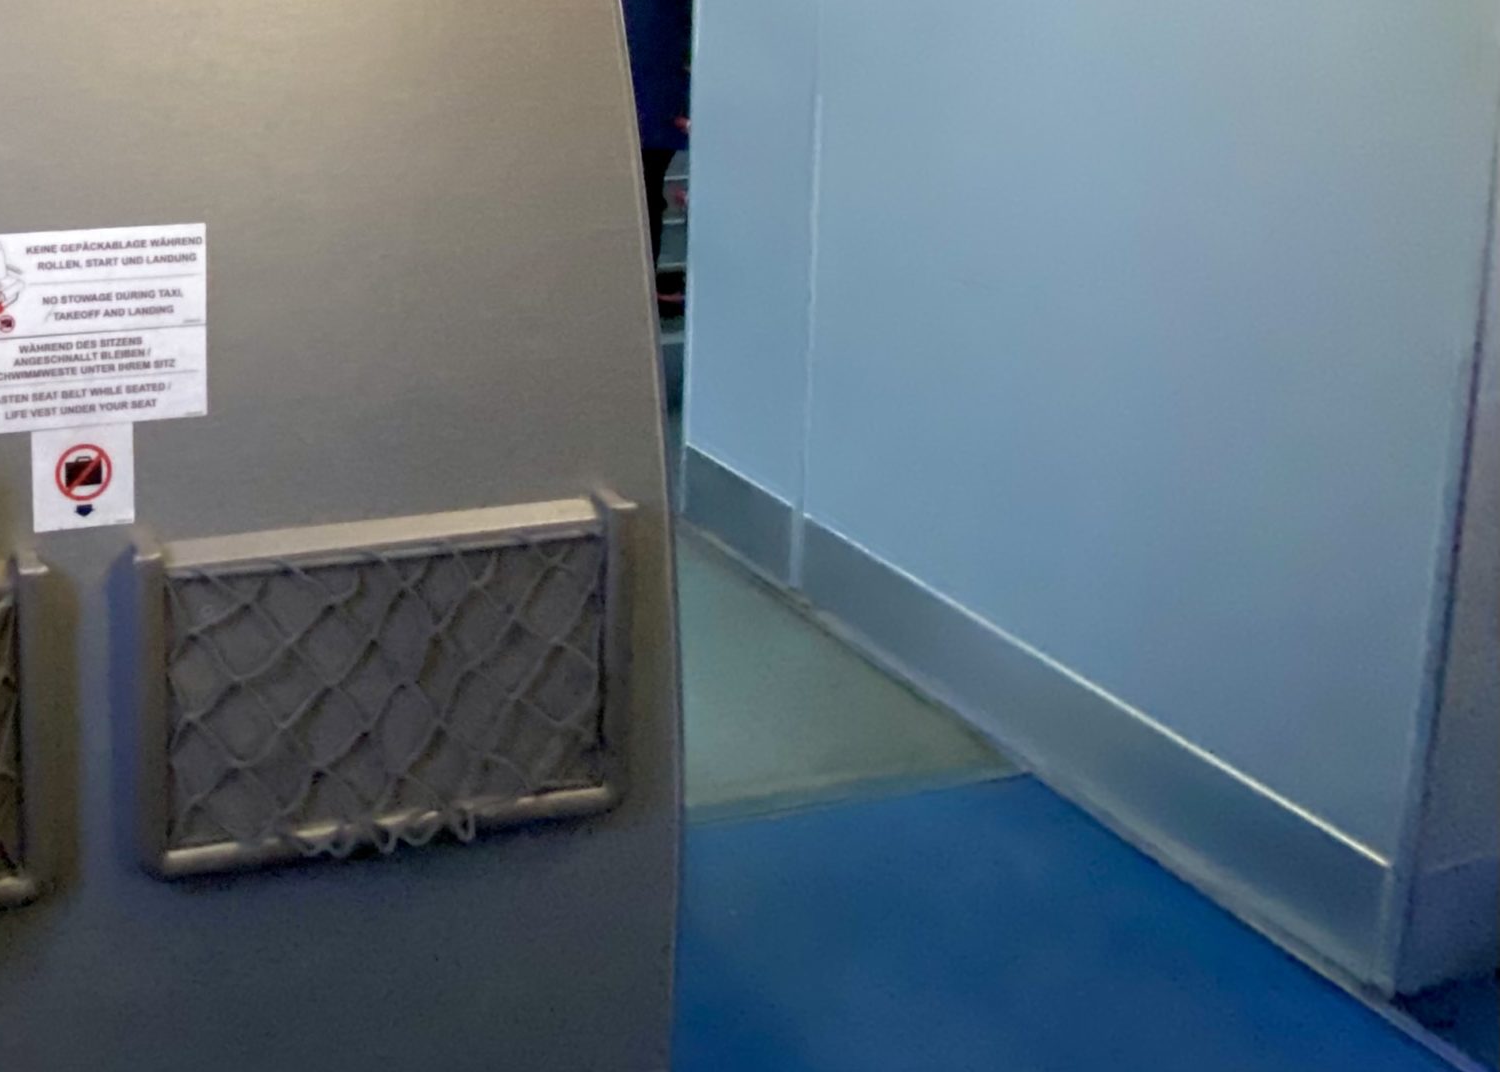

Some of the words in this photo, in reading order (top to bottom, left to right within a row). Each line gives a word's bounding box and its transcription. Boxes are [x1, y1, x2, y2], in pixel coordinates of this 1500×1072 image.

[26, 244, 58, 255] KEINE
[60, 239, 148, 254] GEPÄCKABLAGE
[150, 236, 203, 248] WÄHREND
[37, 259, 82, 271] ROLLEN,
[85, 257, 119, 268] START
[121, 256, 144, 266] UND
[146, 253, 197, 265] LANDUNG
[42, 296, 58, 305] NO
[60, 292, 113, 304] STOWAGE
[115, 289, 156, 301] DURING
[54, 310, 100, 321] TAKEOFF
[103, 308, 125, 317] AND
[128, 305, 174, 316] LANDING
[18, 340, 73, 354] WÄHREND
[76, 340, 97, 350] DES
[100, 337, 143, 348] SITZENS
[13, 353, 98, 367] ANGESCHNALLT
[100, 349, 145, 360] BLEIBEN
[80, 363, 115, 375] UNTER
[118, 361, 151, 372] IHREM
[153, 358, 176, 369] SITZ
[32, 391, 58, 402] SEAT
[61, 389, 87, 399] BELT
[90, 386, 123, 397] WHILE
[125, 383, 165, 394] SEATED
[5, 409, 28, 420] LIFE
[31, 406, 58, 417] VEST
[60, 403, 96, 415] UNDER
[99, 401, 128, 411] YOUR
[131, 399, 157, 409] SEAT
